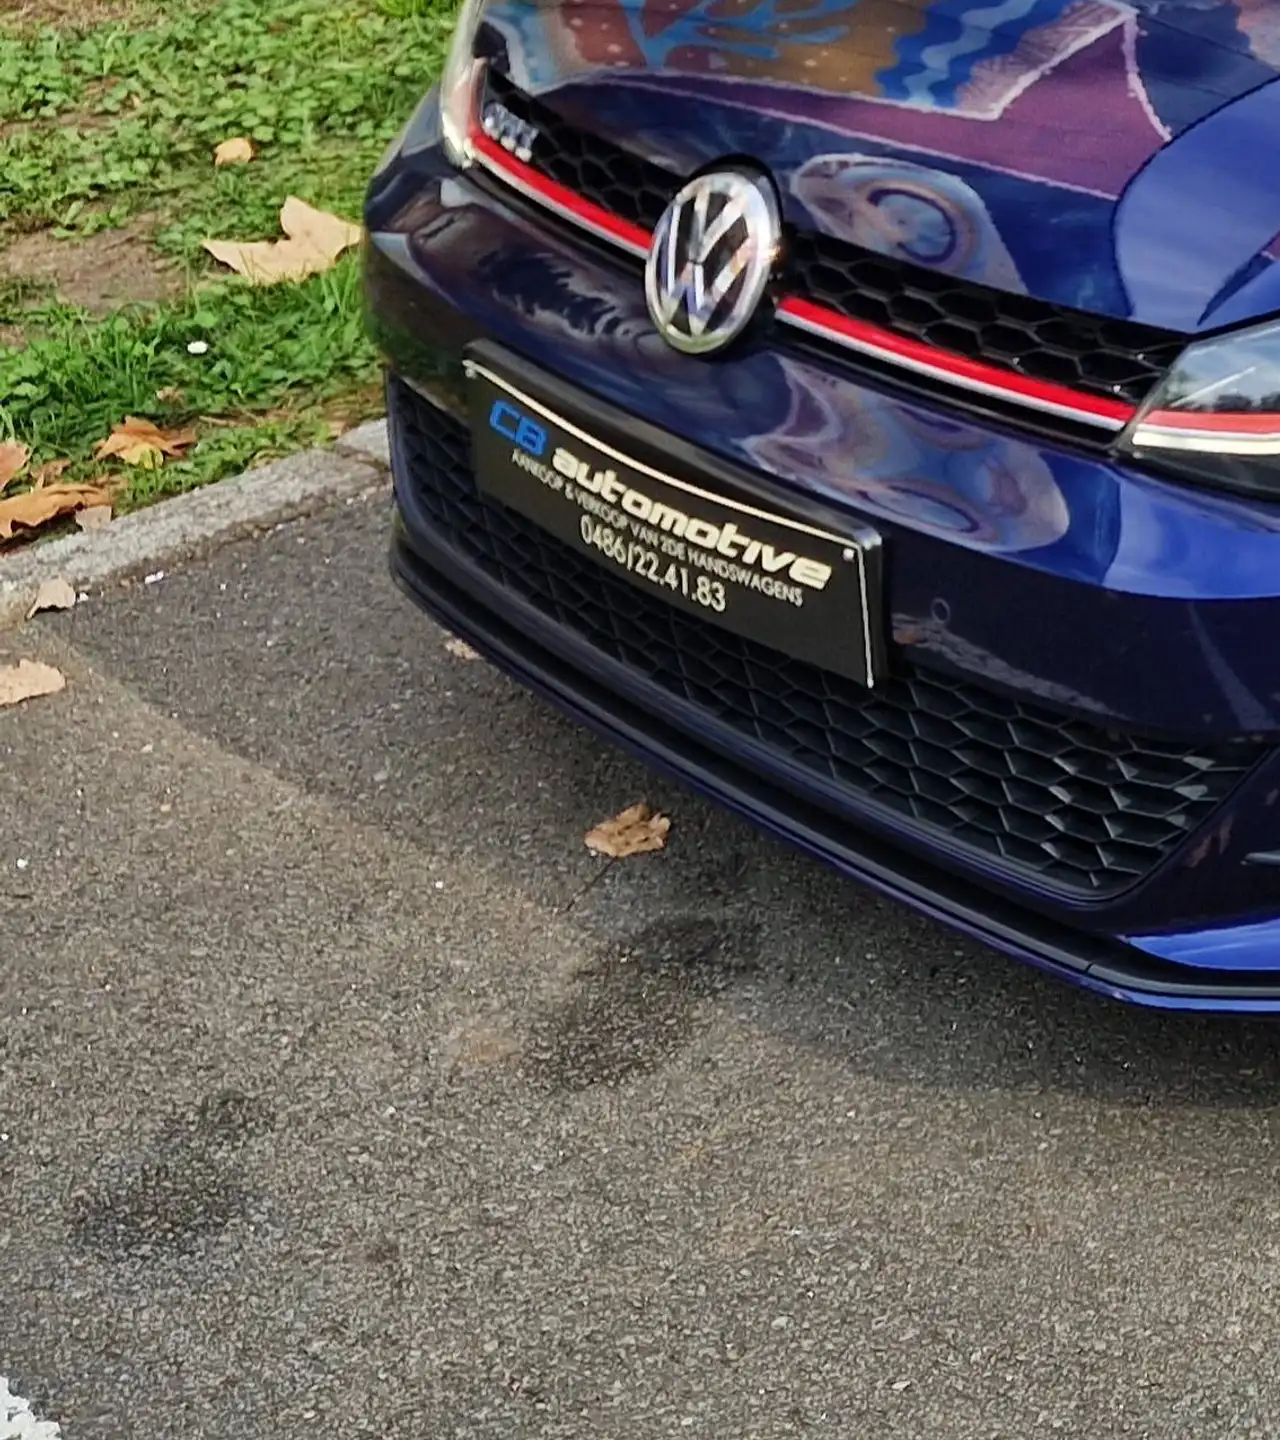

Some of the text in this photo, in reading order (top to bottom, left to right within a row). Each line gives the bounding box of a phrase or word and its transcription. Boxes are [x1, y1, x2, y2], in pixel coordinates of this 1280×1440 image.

[489, 400, 832, 590] CB automotive
[580, 514, 726, 612] 0486/22.41.83
[629, 520, 660, 548] VAN
[660, 534, 686, 561] 2DE
[687, 546, 804, 607] HANDSWAGENS
